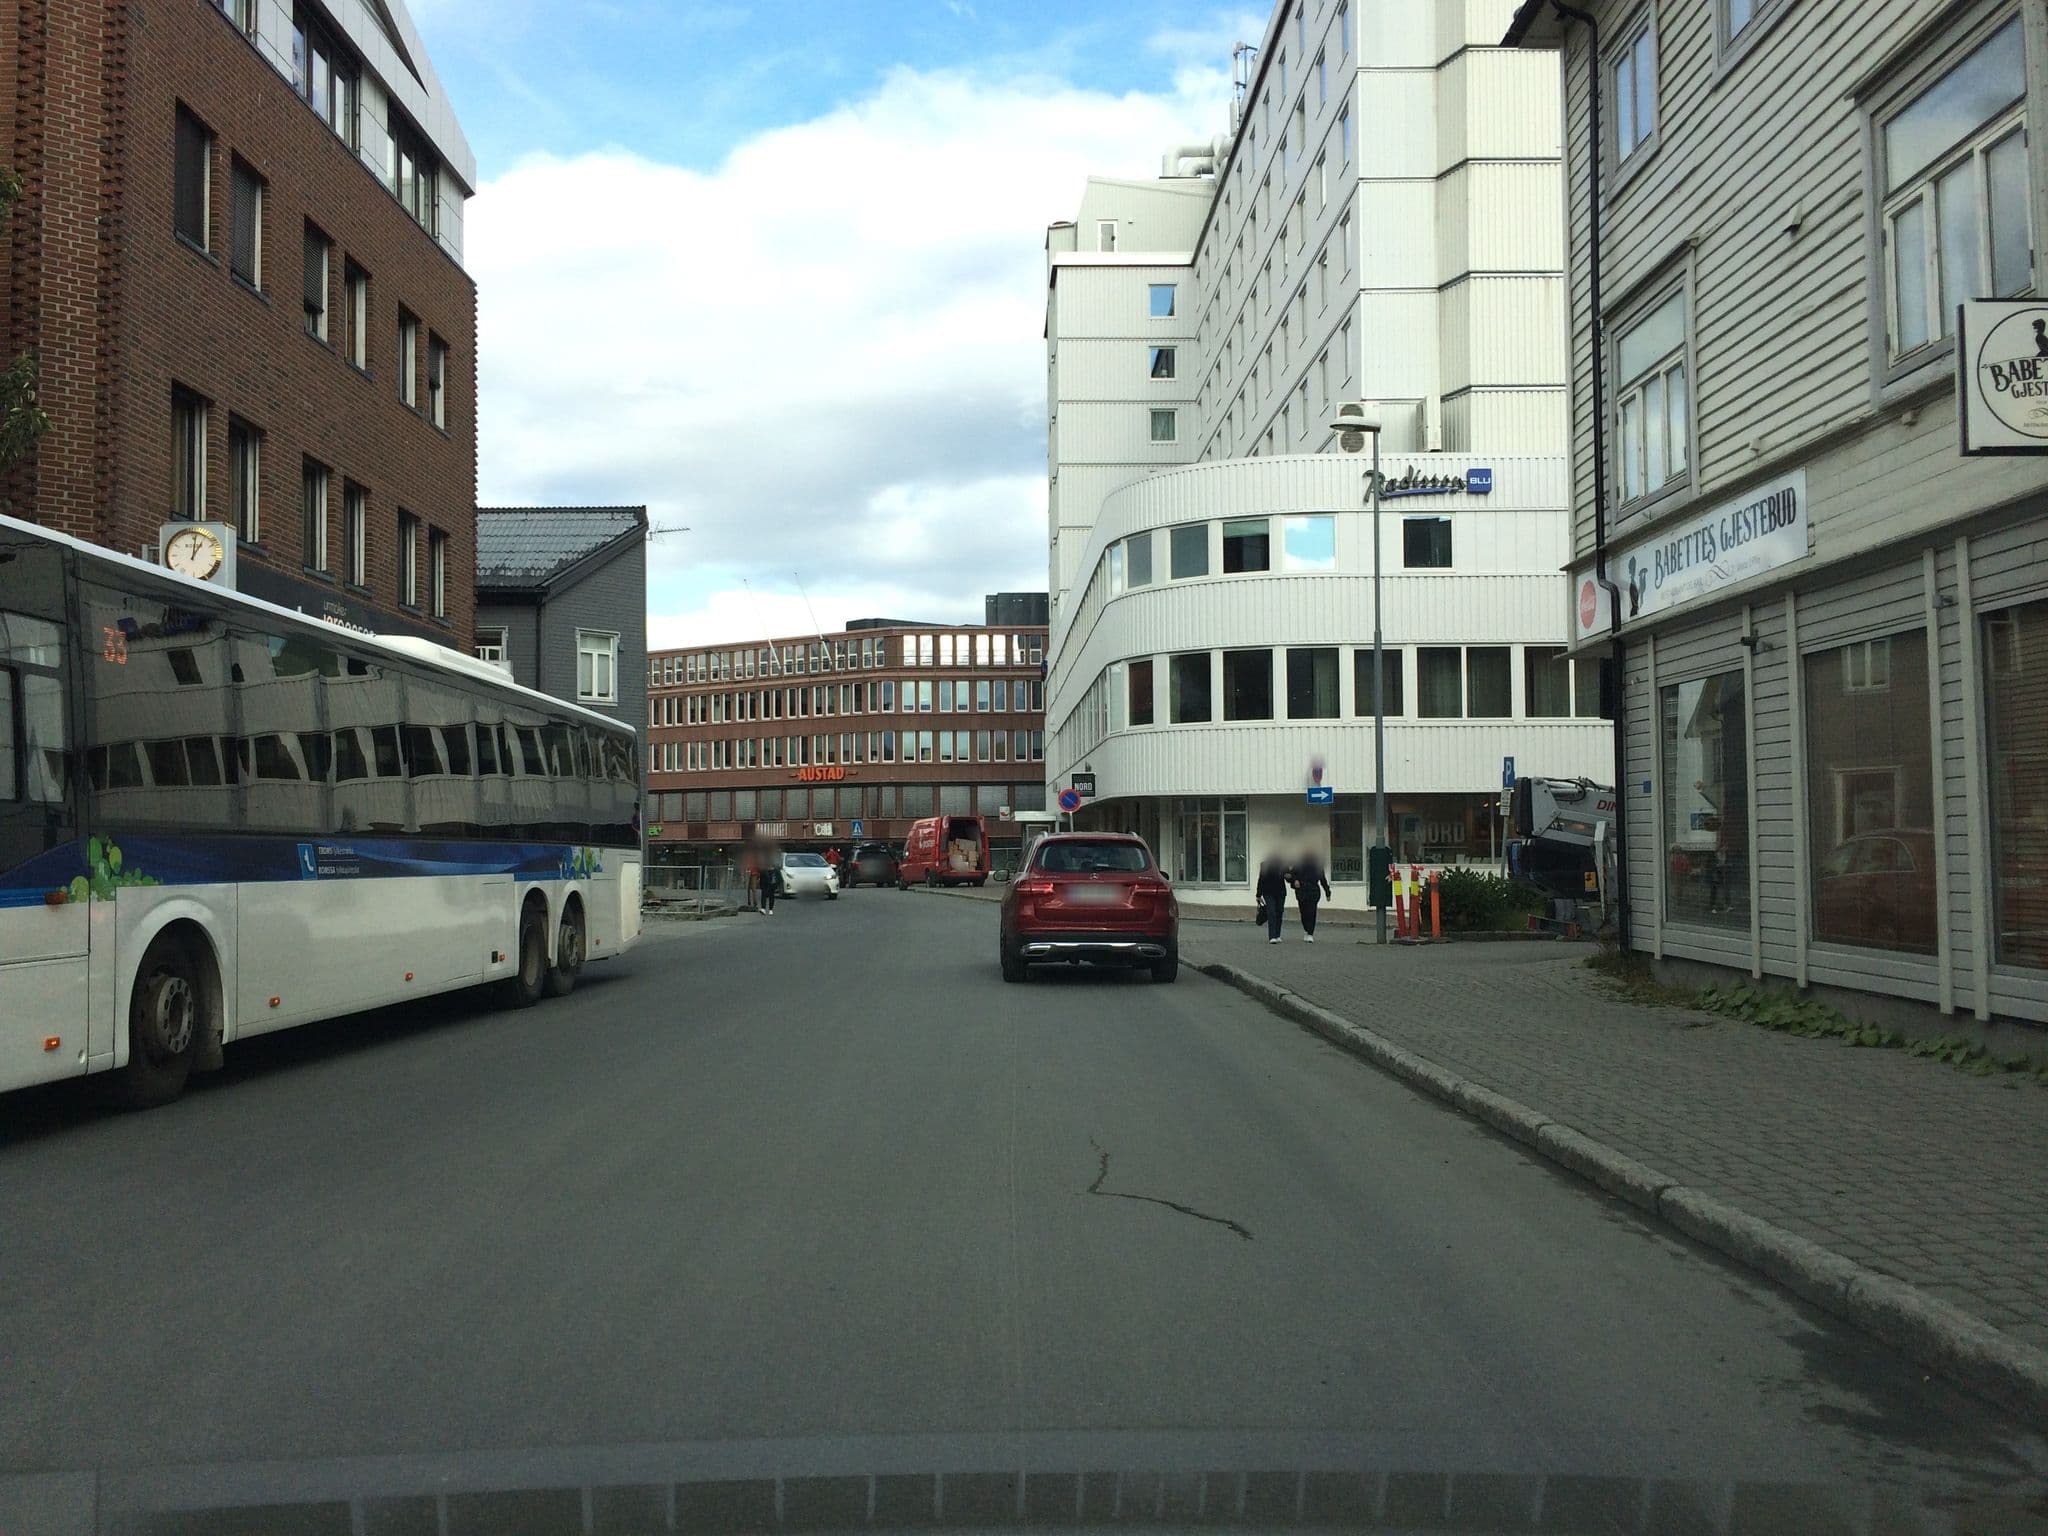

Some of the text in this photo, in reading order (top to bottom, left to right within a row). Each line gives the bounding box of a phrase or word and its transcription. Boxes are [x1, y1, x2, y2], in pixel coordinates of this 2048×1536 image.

[1469, 477, 1491, 485] BLU
[1654, 486, 1797, 590] BABETTES GJESTEBUD
[799, 767, 845, 781] AUSTAD
[1074, 782, 1093, 791] NORD
[1415, 822, 1465, 844] NORD
[1332, 861, 1361, 873] NORD
